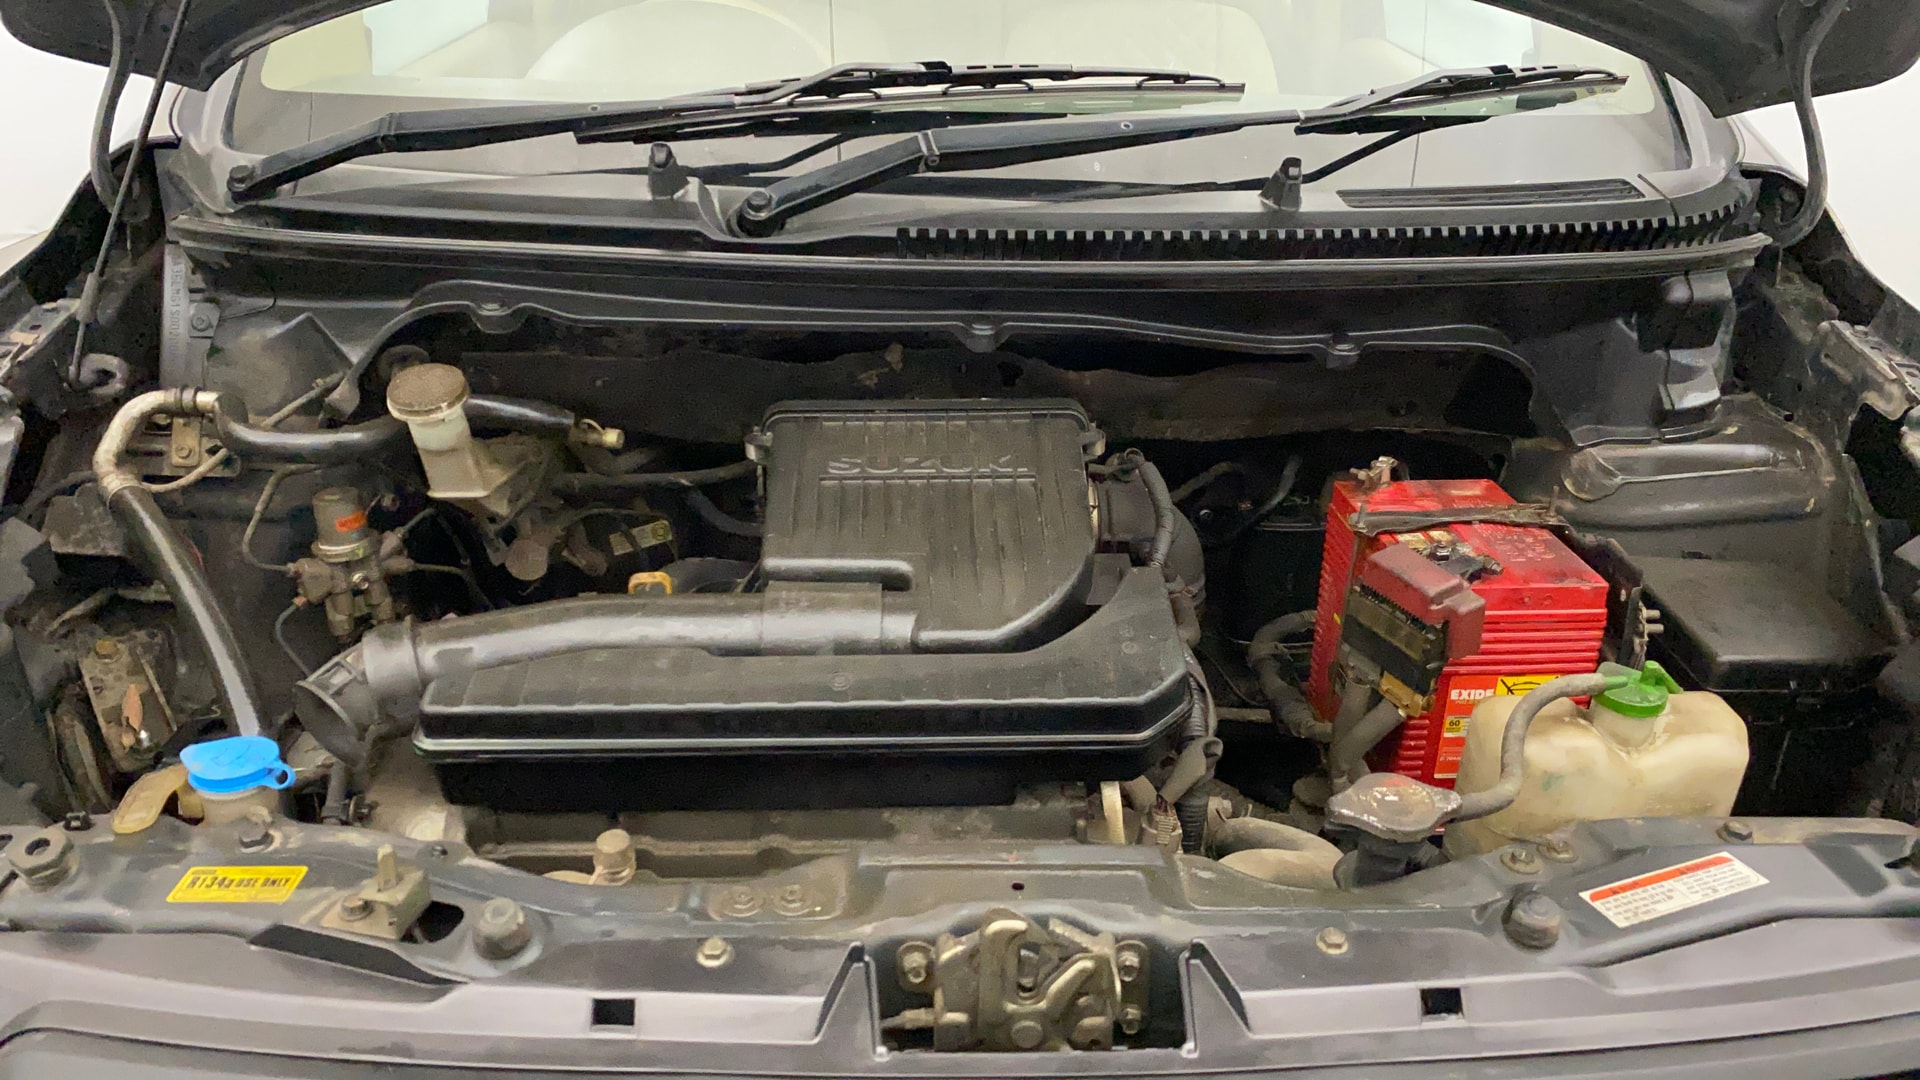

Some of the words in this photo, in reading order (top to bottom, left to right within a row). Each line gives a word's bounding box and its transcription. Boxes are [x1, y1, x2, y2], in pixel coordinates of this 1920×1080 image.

[1451, 689, 1495, 700] EXIDE
[235, 878, 259, 888] USE
[261, 877, 291, 888] ONLY
